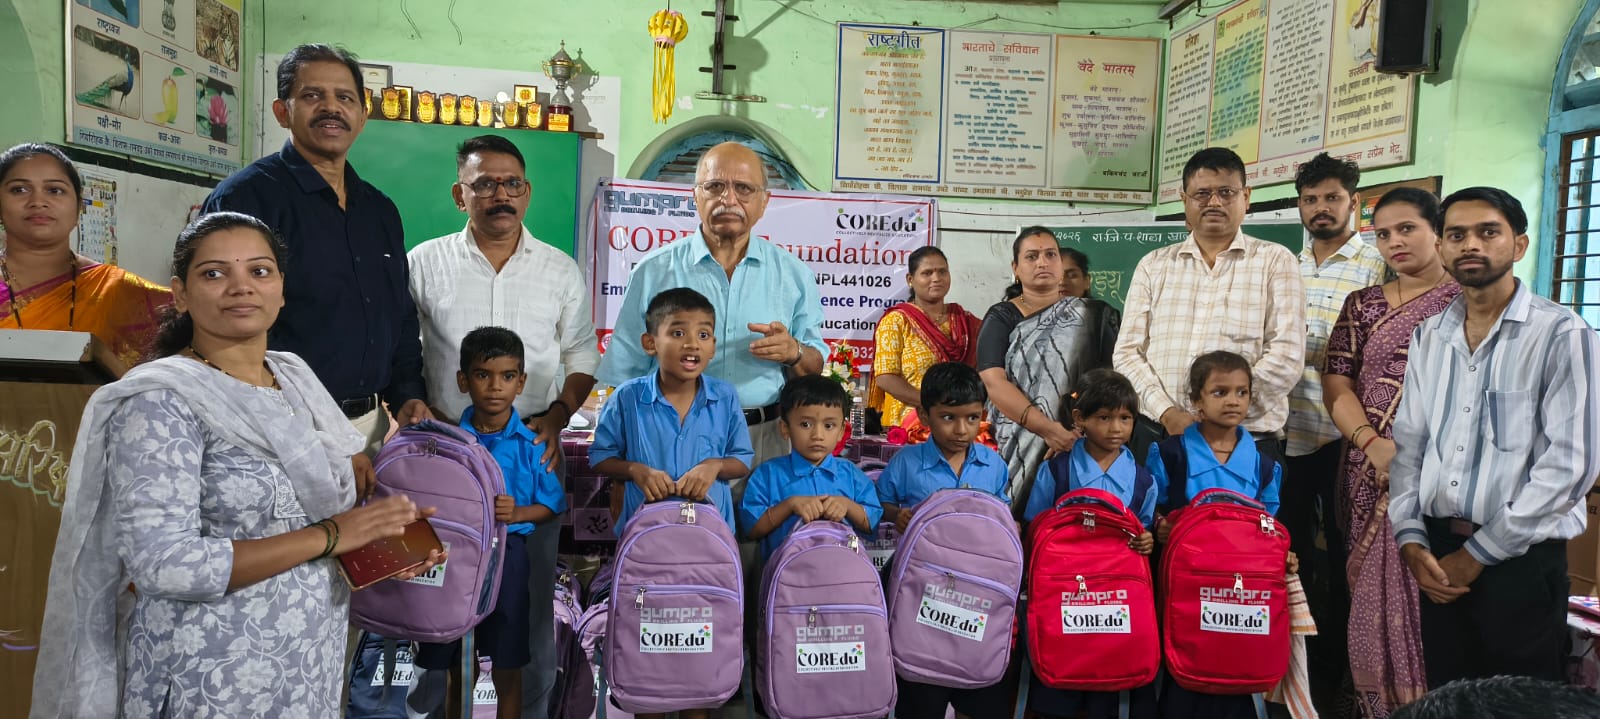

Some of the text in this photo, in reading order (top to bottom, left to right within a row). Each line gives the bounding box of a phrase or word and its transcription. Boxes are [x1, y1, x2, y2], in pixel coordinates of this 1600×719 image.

[867, 31, 922, 50] राष्ट्रगीत
[1102, 62, 1136, 78] मातरम्
[836, 213, 917, 232] COREdu
[757, 235, 913, 266] undation
[814, 273, 892, 288] NPL441026
[602, 283, 626, 296] Em
[820, 296, 855, 308] ence
[820, 319, 876, 331] ucation
[923, 583, 993, 609] gumpro
[1061, 589, 1128, 606] gumpro
[1199, 586, 1272, 604] gumpro
[640, 607, 713, 623] gumpro
[920, 605, 978, 634] COREdu
[1063, 614, 1123, 628] COREdu
[1201, 610, 1263, 628] COREdu
[640, 632, 705, 647] COREdu
[796, 624, 865, 642] gumpro
[797, 652, 858, 667] COREdu
